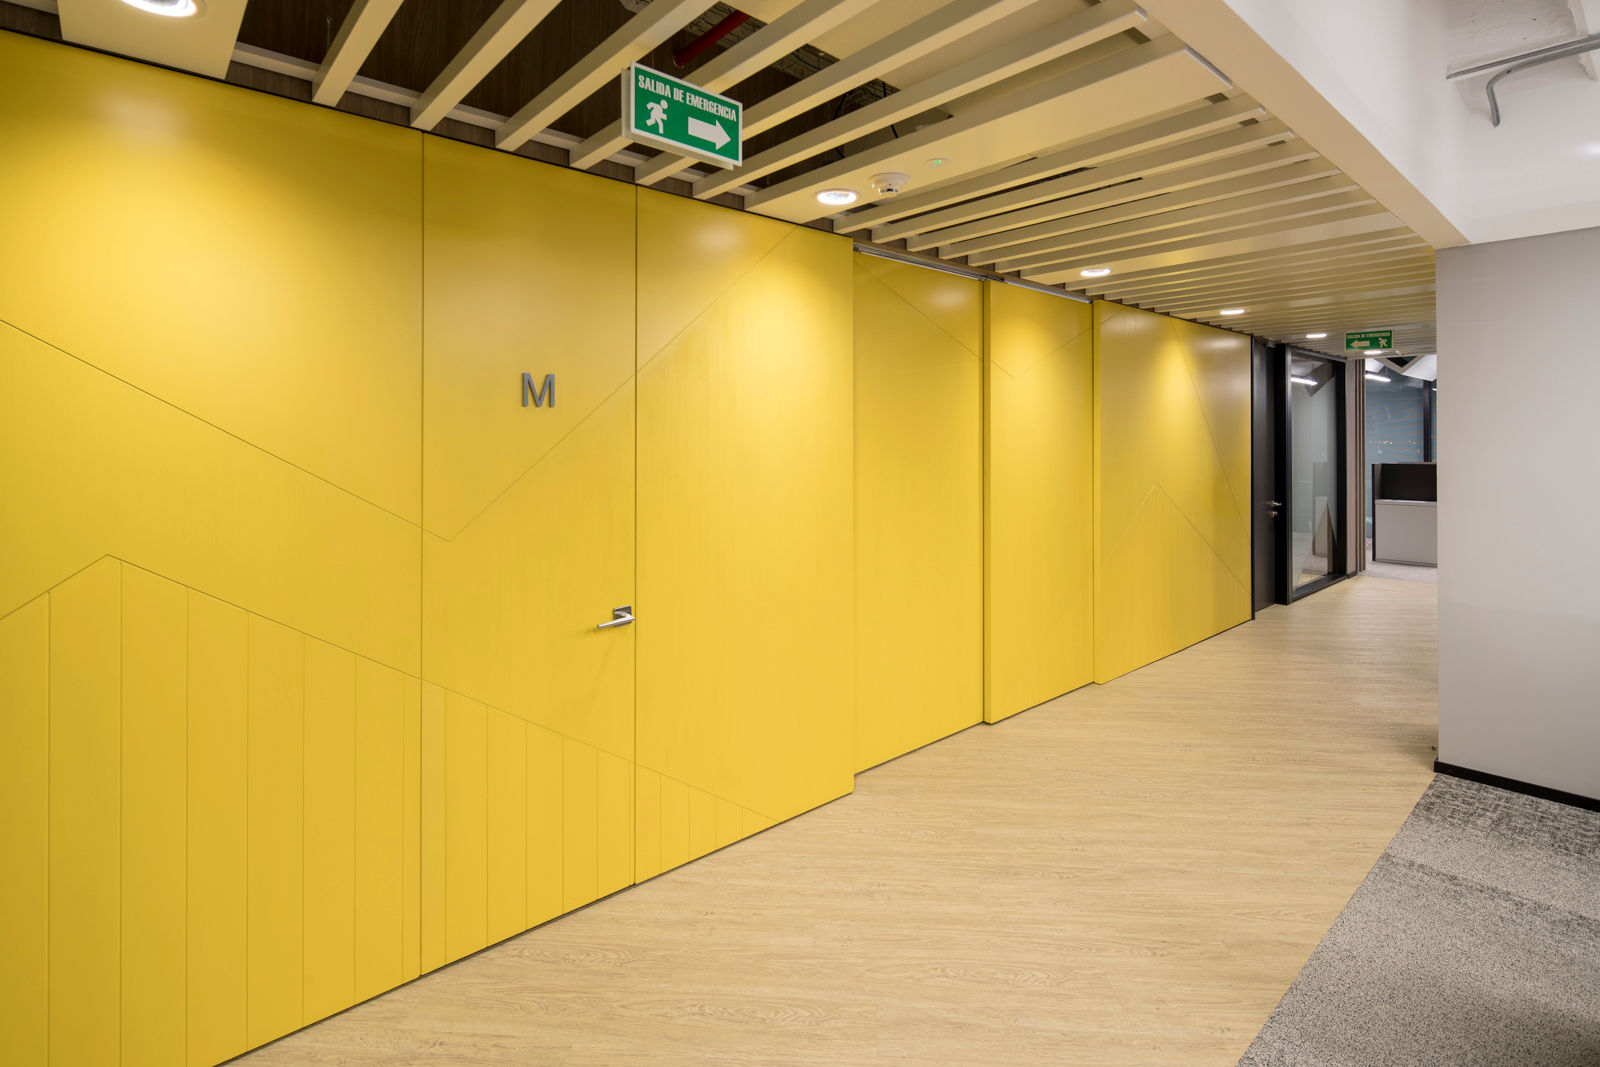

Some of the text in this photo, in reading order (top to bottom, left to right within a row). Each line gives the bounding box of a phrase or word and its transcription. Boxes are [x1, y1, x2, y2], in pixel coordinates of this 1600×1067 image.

[638, 75, 737, 121] SALIDA DE EMERGENCIA
[522, 372, 555, 408] M
